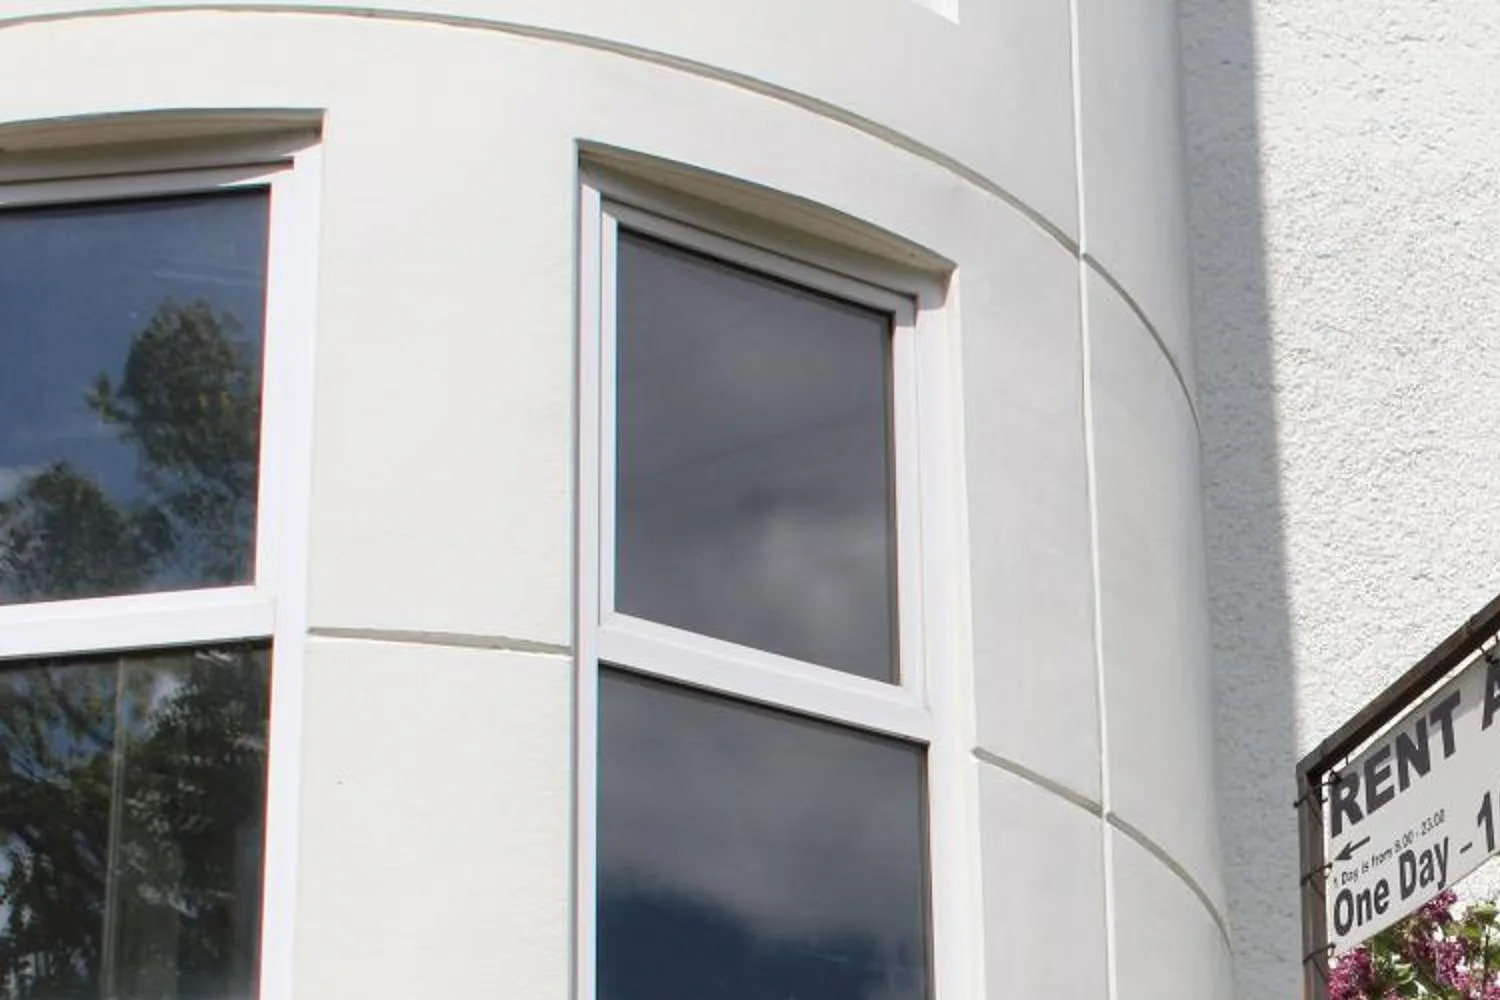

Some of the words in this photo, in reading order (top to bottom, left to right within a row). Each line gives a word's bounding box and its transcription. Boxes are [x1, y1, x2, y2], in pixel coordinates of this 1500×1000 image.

[1331, 690, 1460, 838] RENT
[1333, 878, 1390, 937] One
[1398, 836, 1449, 901] Day
[1459, 841, 1473, 854] -
[1371, 848, 1393, 868] from
